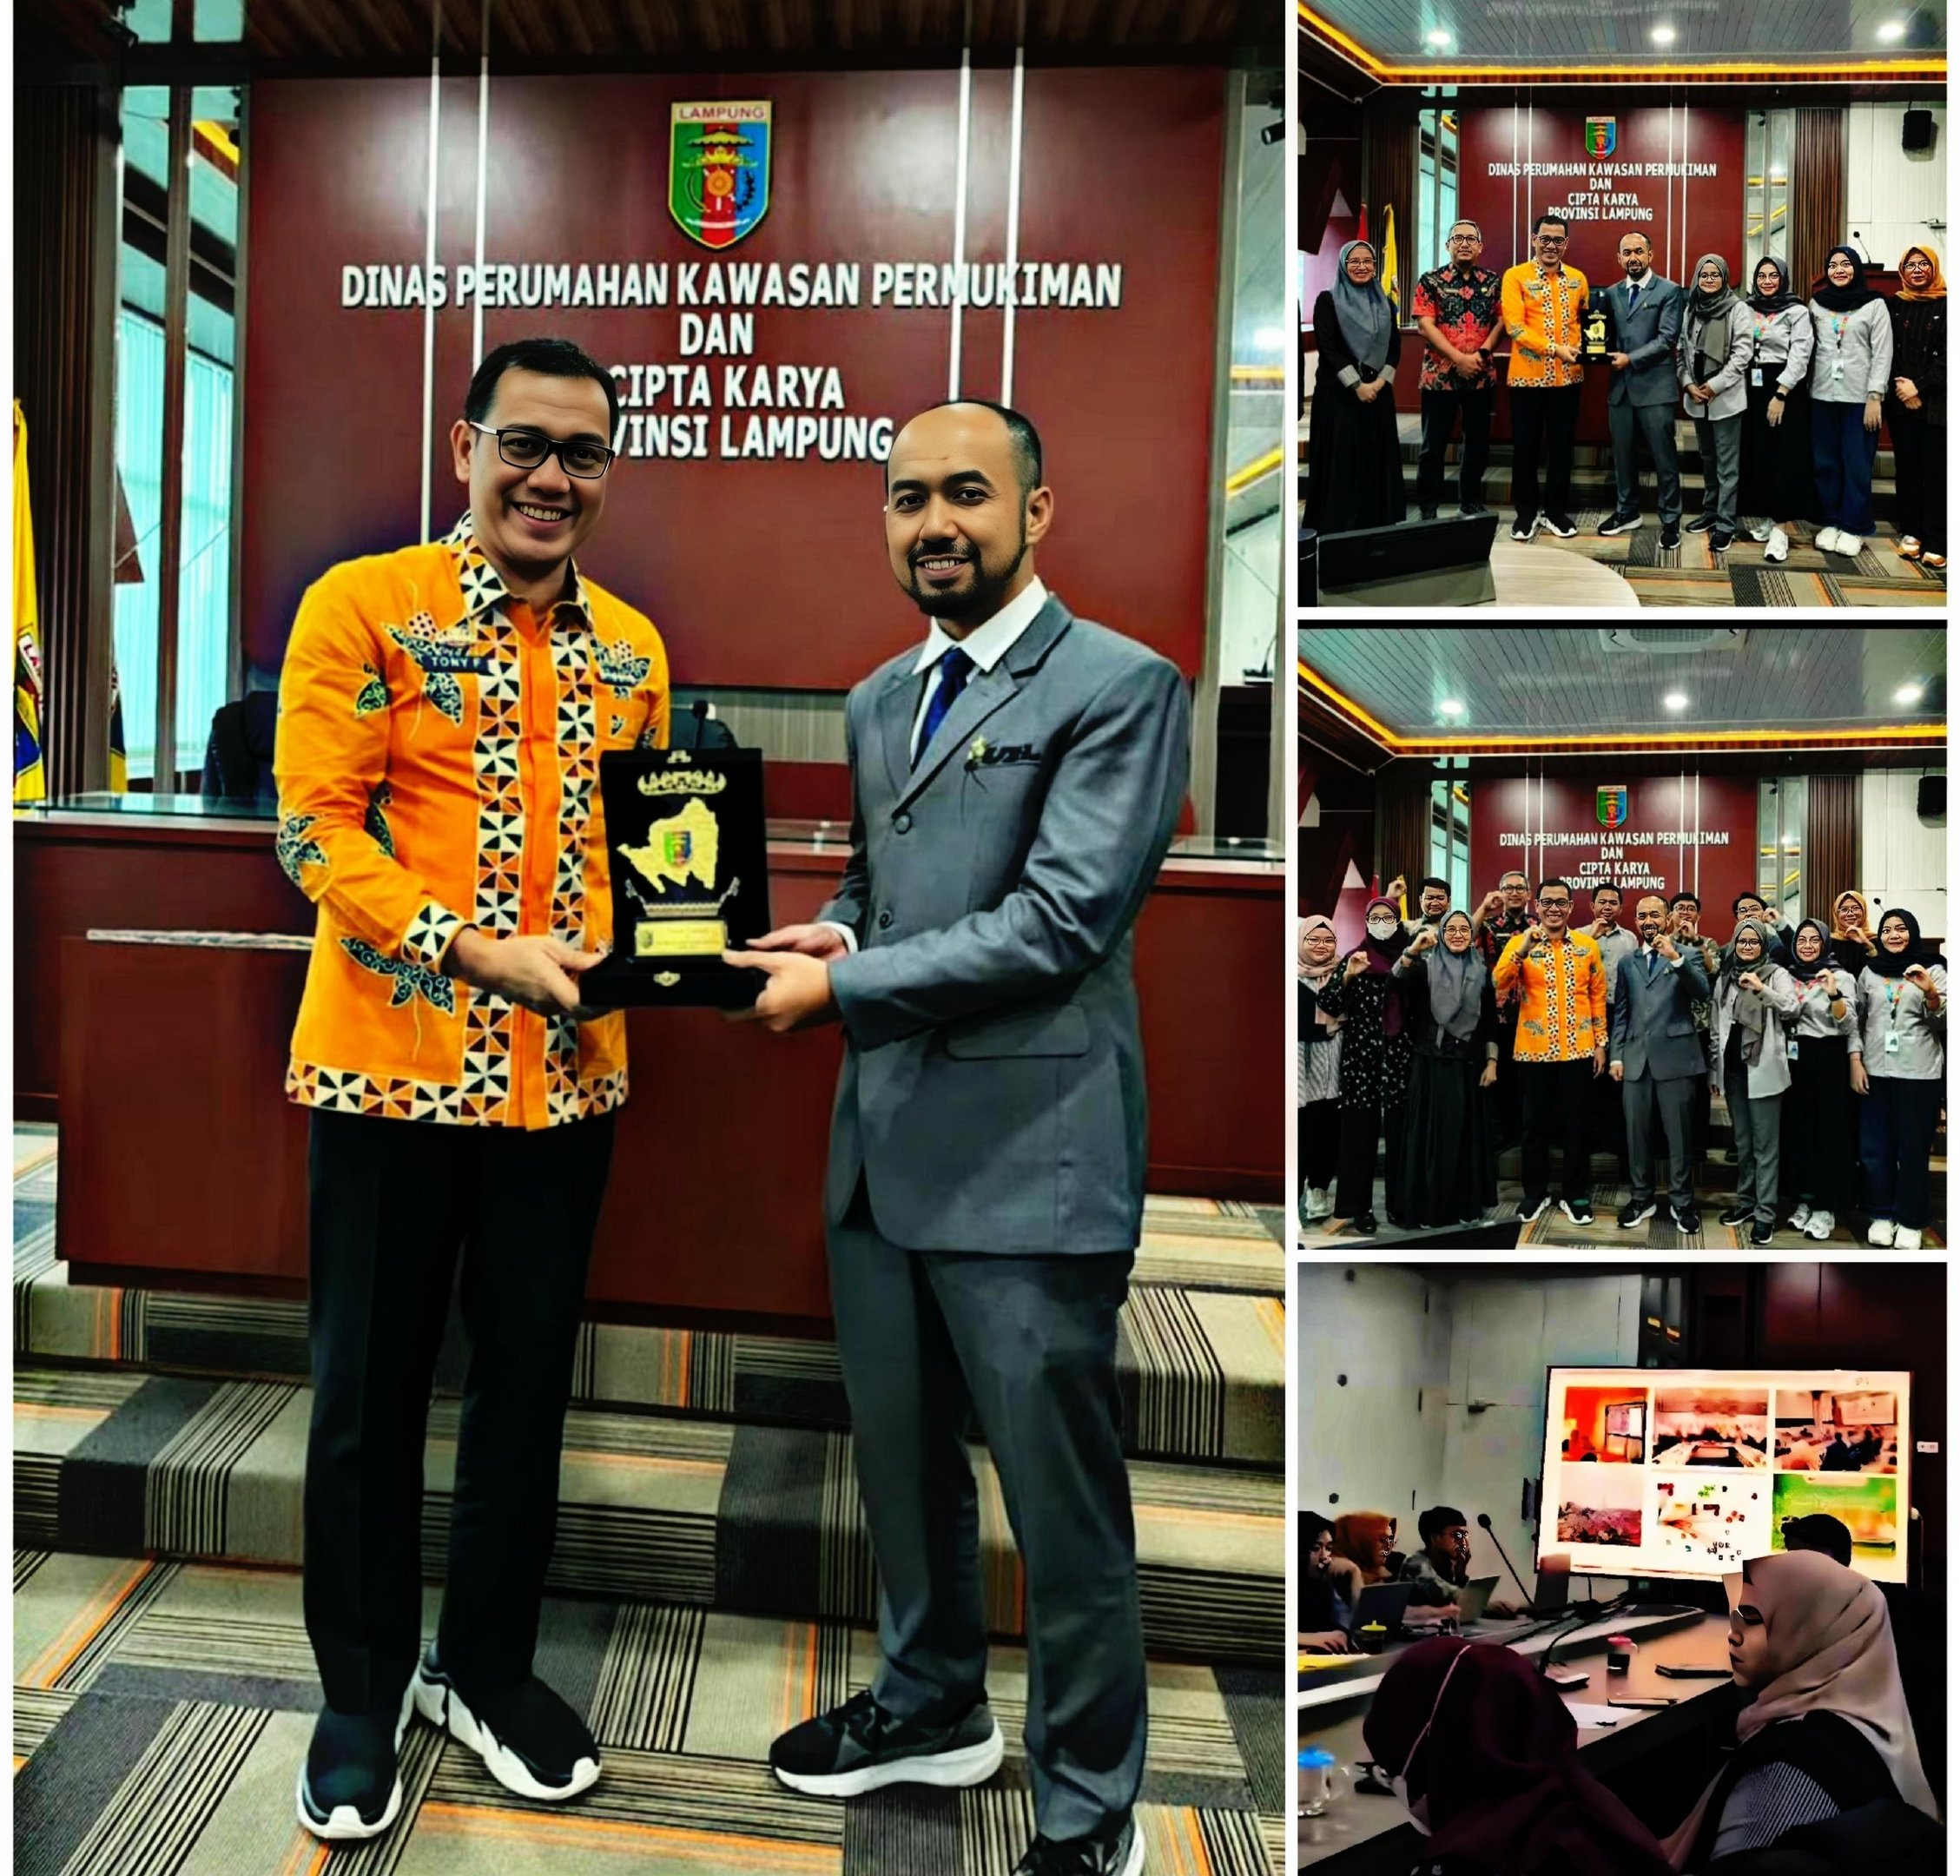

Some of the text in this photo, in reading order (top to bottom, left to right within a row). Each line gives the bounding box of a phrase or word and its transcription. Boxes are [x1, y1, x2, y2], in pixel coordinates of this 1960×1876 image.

[679, 106, 765, 120] LAMPUNG
[1488, 162, 1717, 177] DINAS PERUMAHAN KAWASAN PERMUKIMAN
[1589, 177, 1613, 190] DAN
[1567, 192, 1639, 207] CIPTA KARYA
[1548, 207, 1653, 221] PROVINSI LAMPUNG
[341, 261, 1122, 308] DINAS PERUMAHAN KAWASAN PERMUKIMAN
[679, 312, 754, 356] DAN
[608, 365, 846, 410] CIPTA KARYA
[612, 414, 894, 462] VINSI LAMPUNG
[431, 656, 469, 668] TONY
[1499, 831, 1730, 846] DINAS PERUMAHAN KAWASAN PERMUKIMAN
[1600, 846, 1624, 860] DAN
[1579, 861, 1651, 875] CIPTA KARYA
[1614, 876, 1666, 890] LAMPUNG
